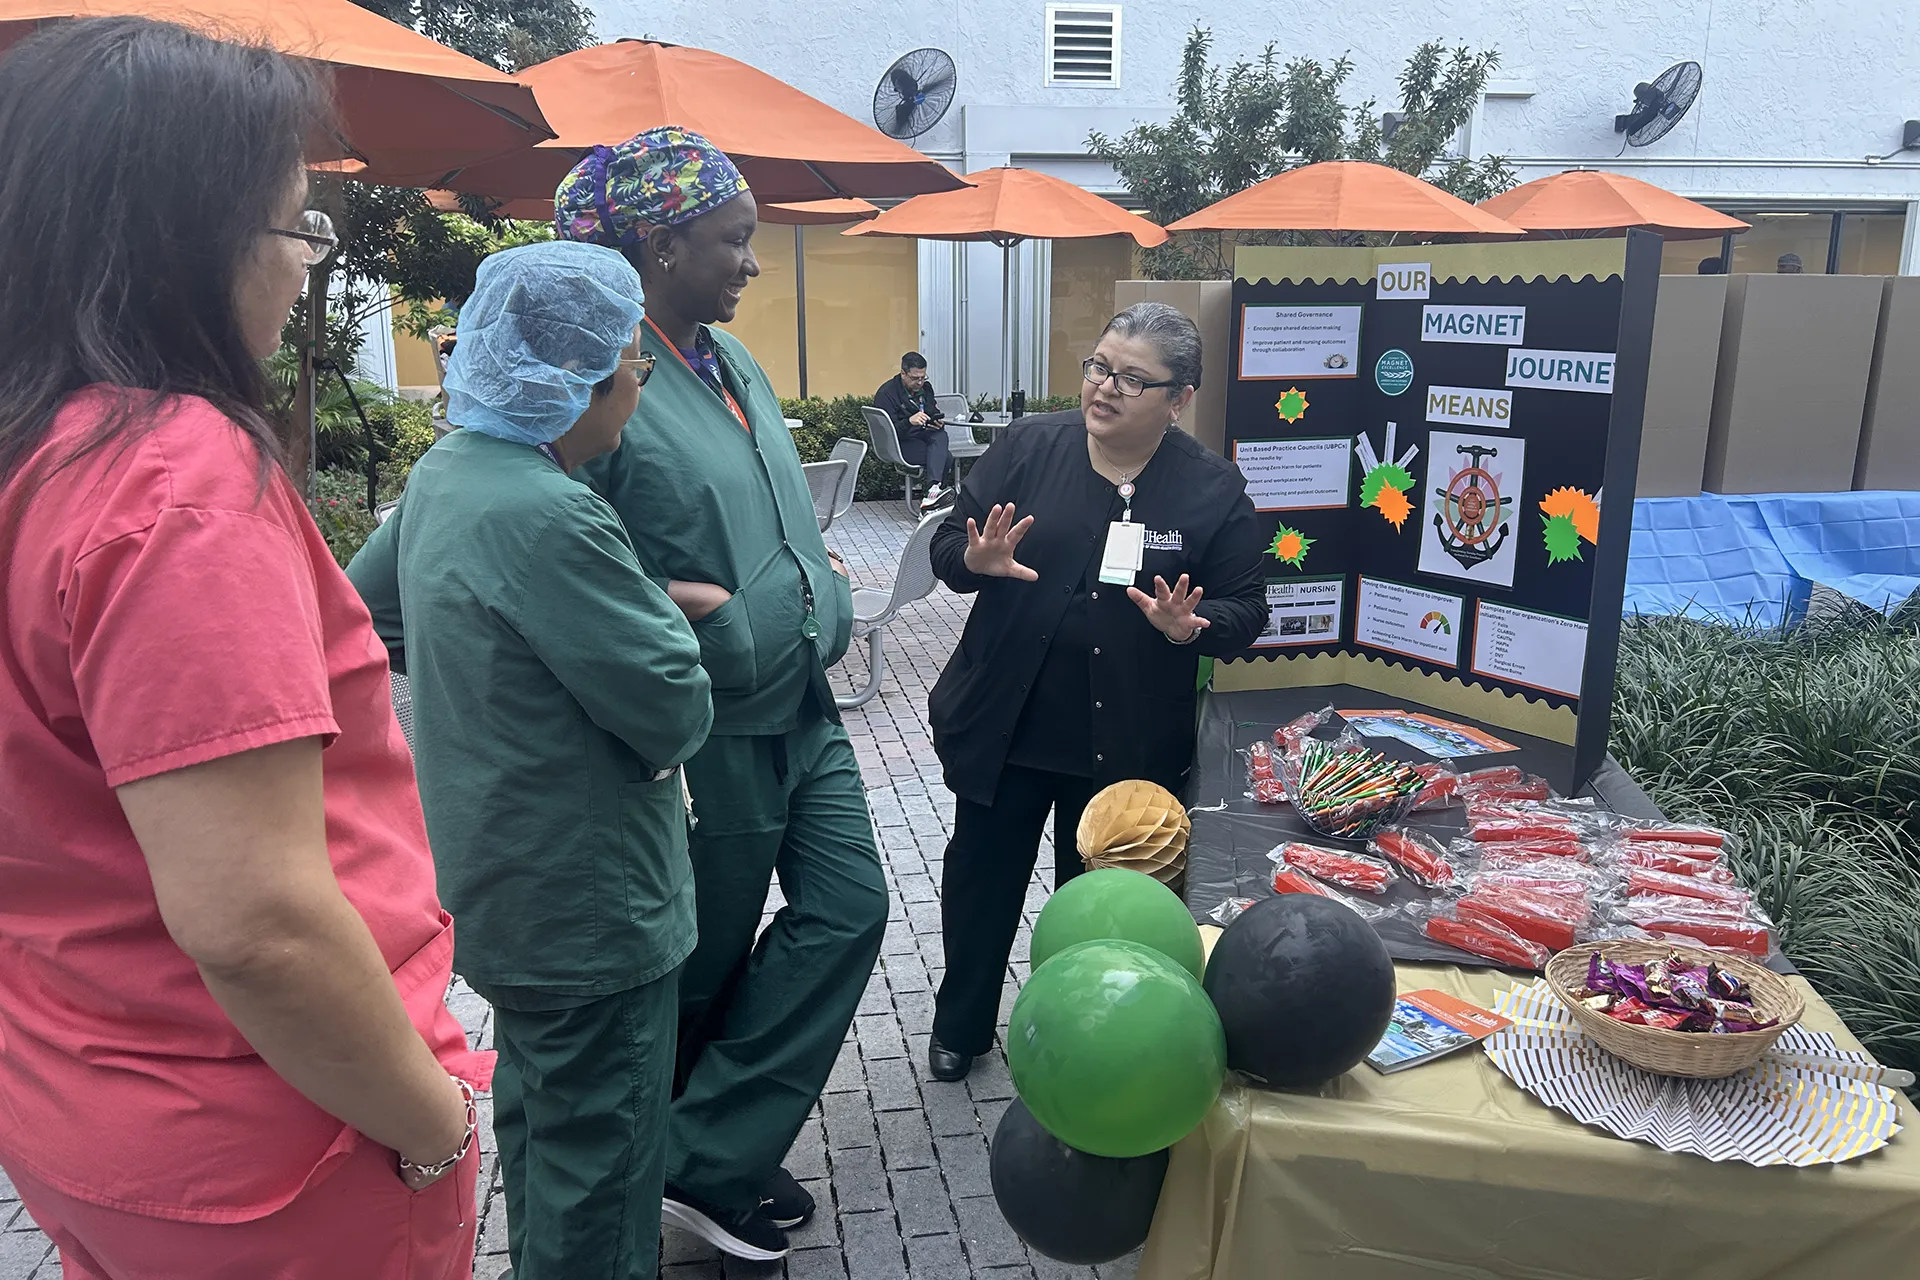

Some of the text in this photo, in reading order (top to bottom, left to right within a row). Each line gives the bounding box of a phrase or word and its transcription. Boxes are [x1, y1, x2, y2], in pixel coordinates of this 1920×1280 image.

[1380, 270, 1427, 292] OUR
[1424, 312, 1523, 336] MAGNET
[1507, 356, 1616, 384] JOURNE
[1429, 392, 1510, 420] MEANS
[1268, 584, 1336, 595] Health NURSING
[1361, 580, 1378, 589] Moving
[1388, 585, 1405, 593] needle
[1405, 588, 1425, 597] forward
[1374, 592, 1389, 600] Patient
[1373, 604, 1409, 616] Patient outcomes
[1480, 603, 1505, 614] Examples
[1521, 613, 1559, 625] organization's
[1560, 620, 1573, 628] Zero
[1573, 623, 1588, 631] Harm
[1385, 620, 1405, 628] outcomes
[1371, 636, 1395, 645] ambulatory
[1372, 630, 1391, 638] Achieving
[1419, 640, 1438, 650] inpatient
[1494, 658, 1512, 667] Surgical
[1493, 665, 1522, 676] Patient Burns
